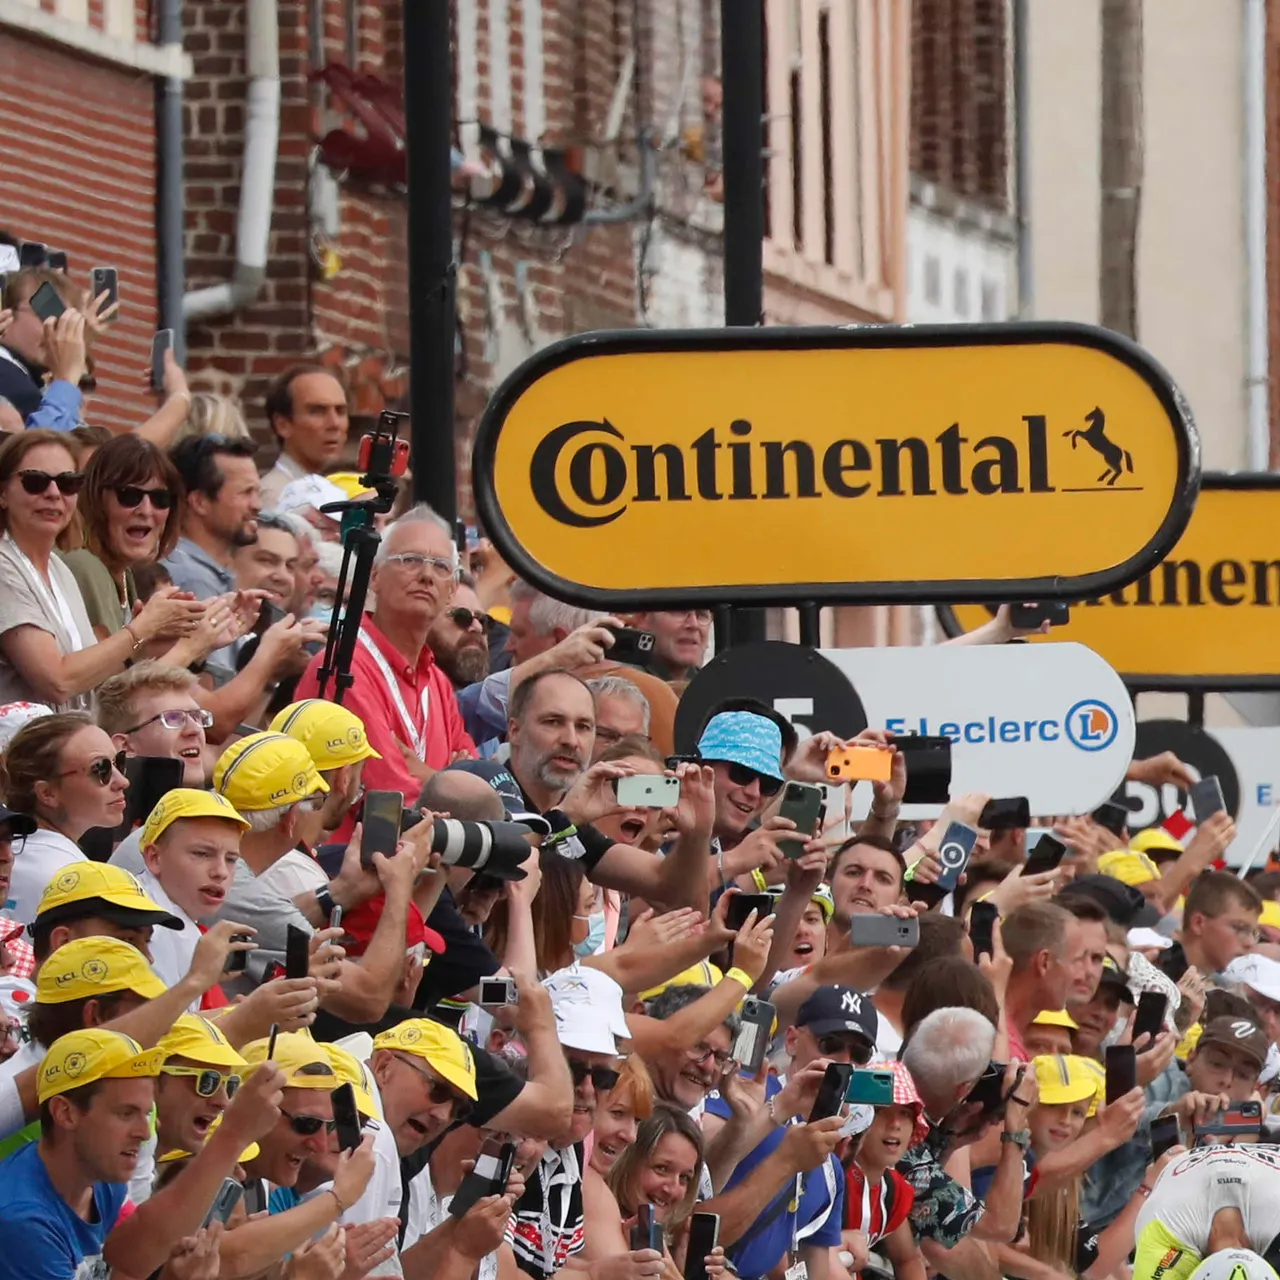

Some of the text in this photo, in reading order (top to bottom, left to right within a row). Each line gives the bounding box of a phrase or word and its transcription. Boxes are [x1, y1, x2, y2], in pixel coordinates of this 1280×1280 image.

[529, 414, 1057, 528] Continental
[326, 739, 345, 749] LCL
[270, 789, 290, 800] LCL
[56, 973, 77, 984] LCL
